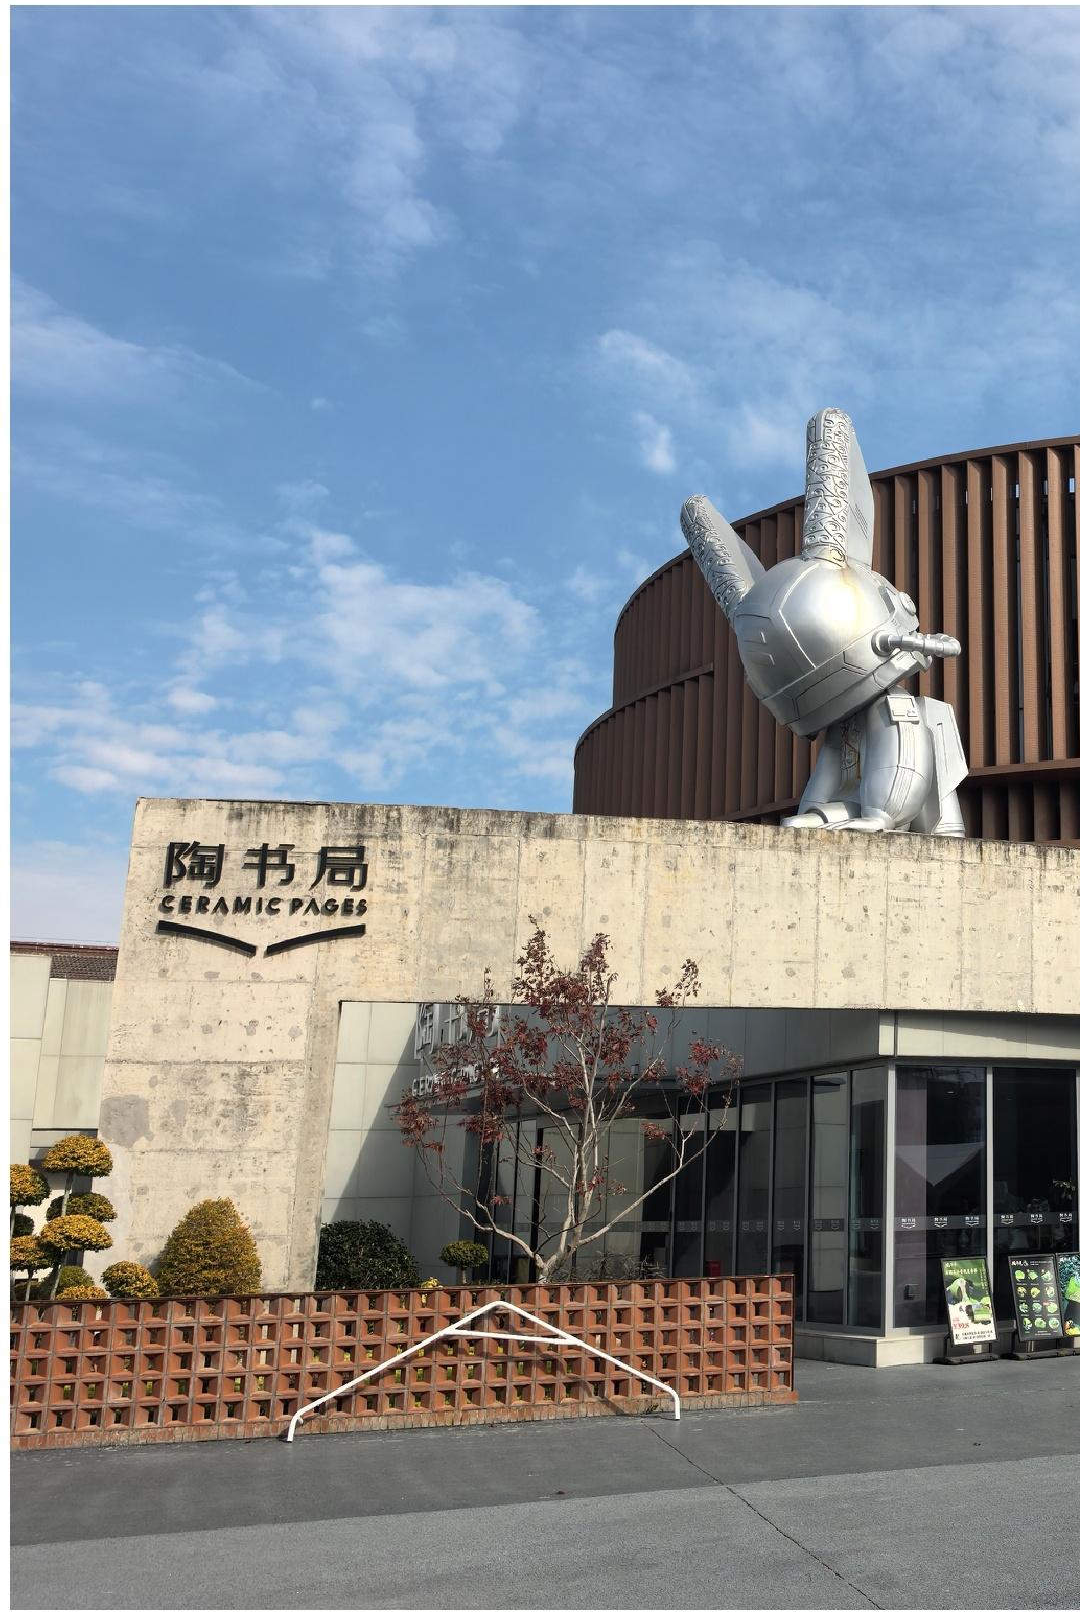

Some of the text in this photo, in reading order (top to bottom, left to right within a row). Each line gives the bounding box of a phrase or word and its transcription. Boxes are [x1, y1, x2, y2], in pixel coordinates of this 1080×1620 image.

[163, 841, 369, 892] 陶书局
[159, 894, 368, 917] CERAMIC PAGES
